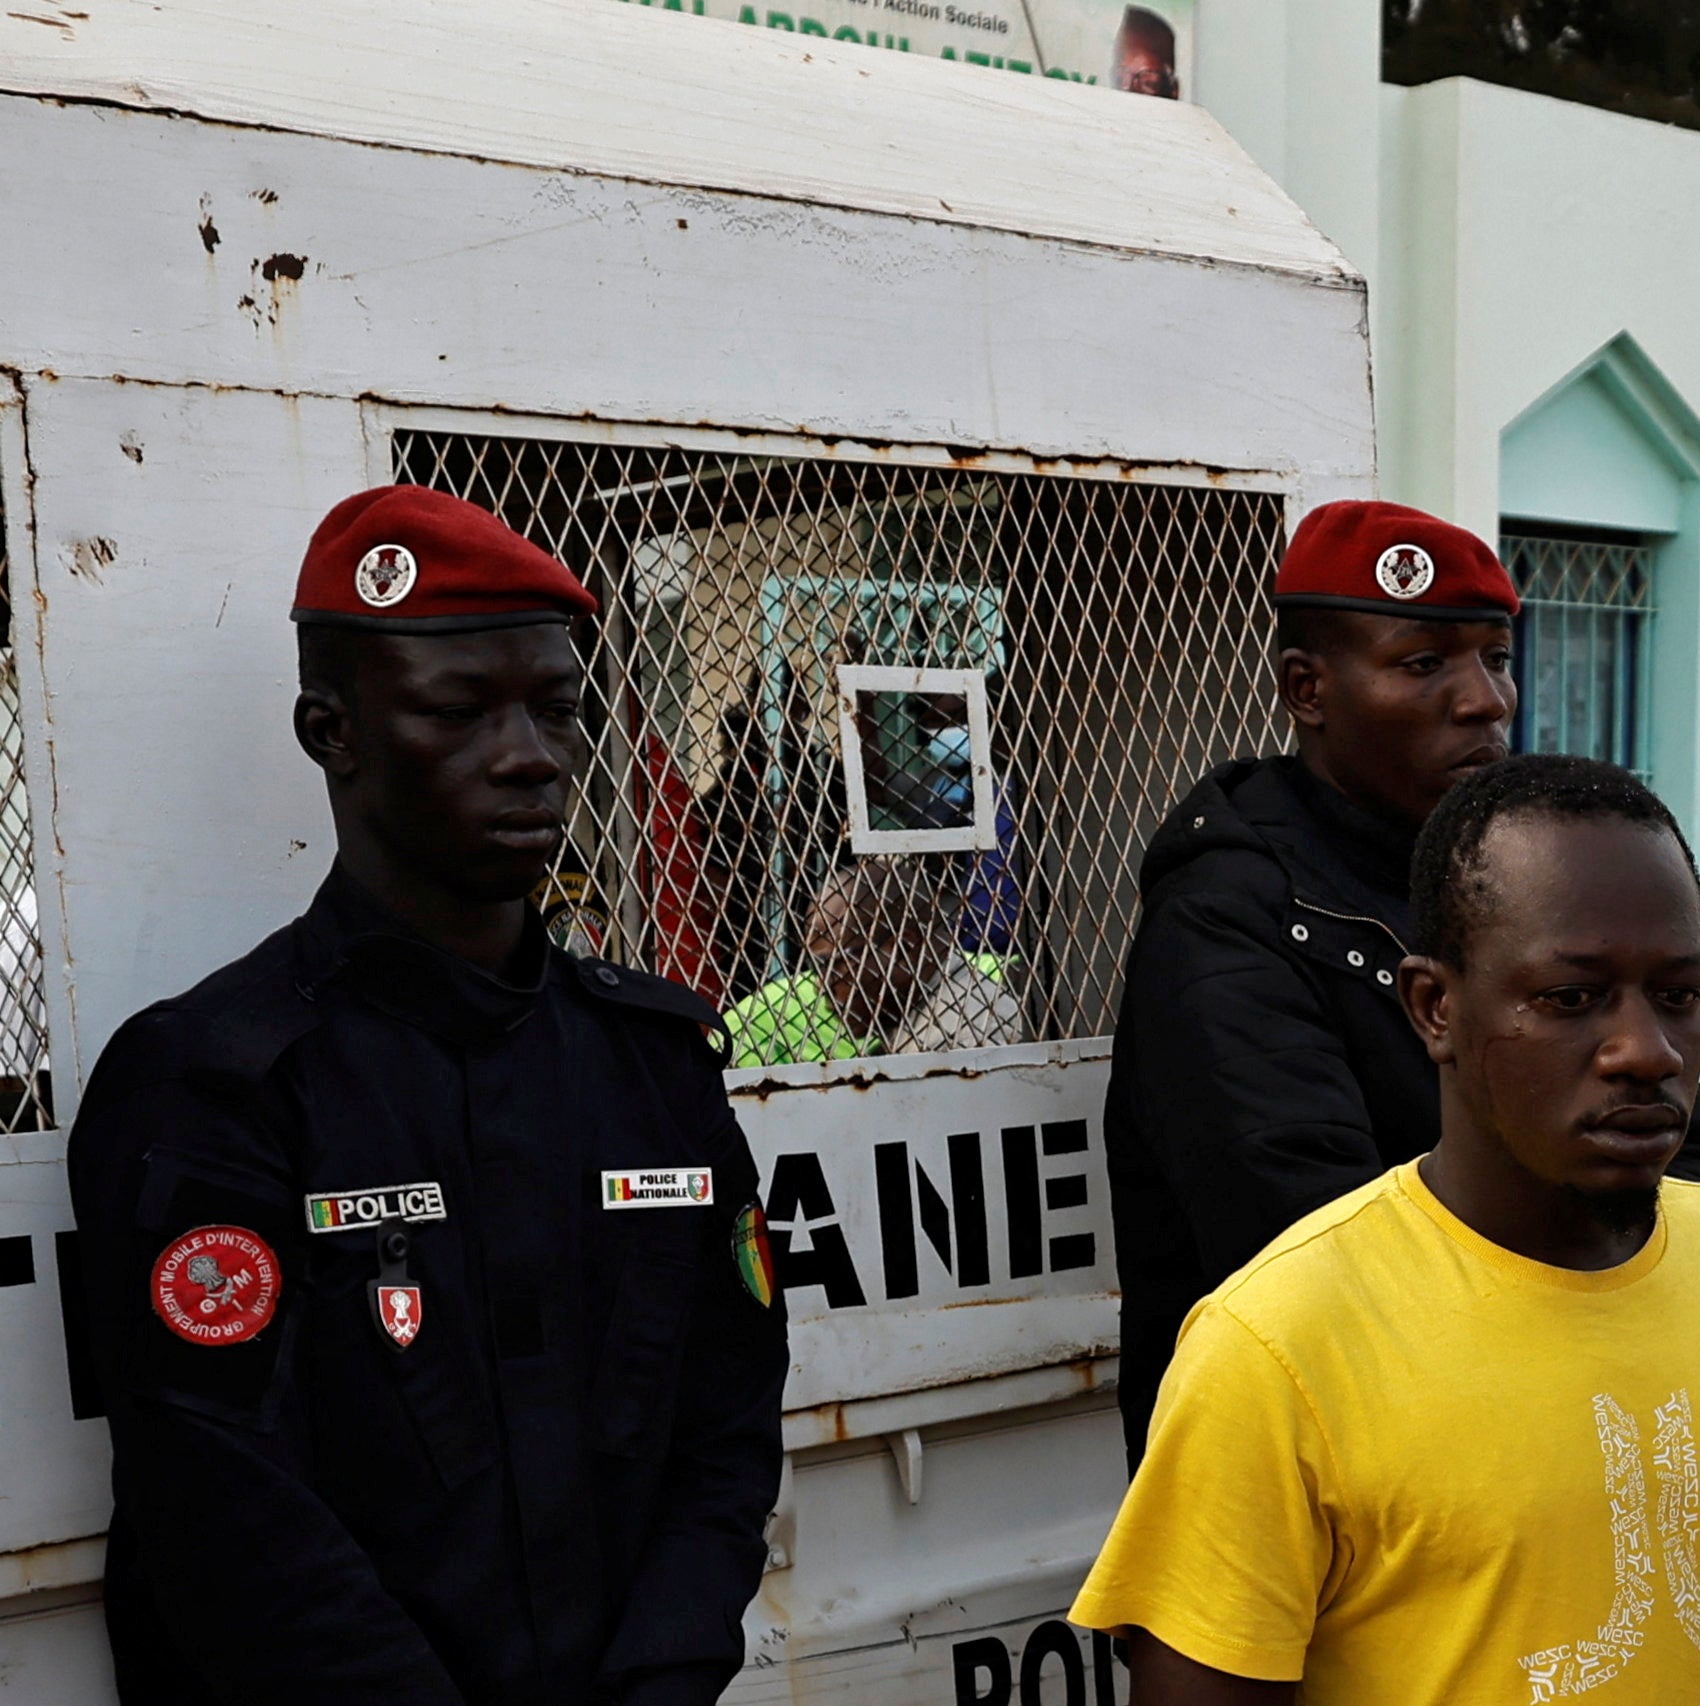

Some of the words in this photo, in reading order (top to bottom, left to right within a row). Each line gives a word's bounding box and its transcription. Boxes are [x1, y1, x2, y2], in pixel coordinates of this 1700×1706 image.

[945, 4, 1008, 34] Sociale
[629, 1187, 688, 1199] NATIONALE
[637, 1173, 678, 1185] POLICE
[336, 1189, 441, 1224] POLICE
[160, 1237, 204, 1282] MOBILE
[205, 1232, 273, 1317] D'INTERVENTION
[160, 1285, 244, 1338] GROUPEMENT
[1592, 1393, 1614, 1453] wesc
[1682, 1442, 1699, 1508] wesc
[1610, 1506, 1646, 1536] wesc
[1615, 1536, 1626, 1586] wesc
[1576, 1639, 1617, 1657] wesc
[1597, 1625, 1644, 1646] wesc
[1517, 1644, 1571, 1669] wesc
[1570, 1663, 1618, 1694] wesc
